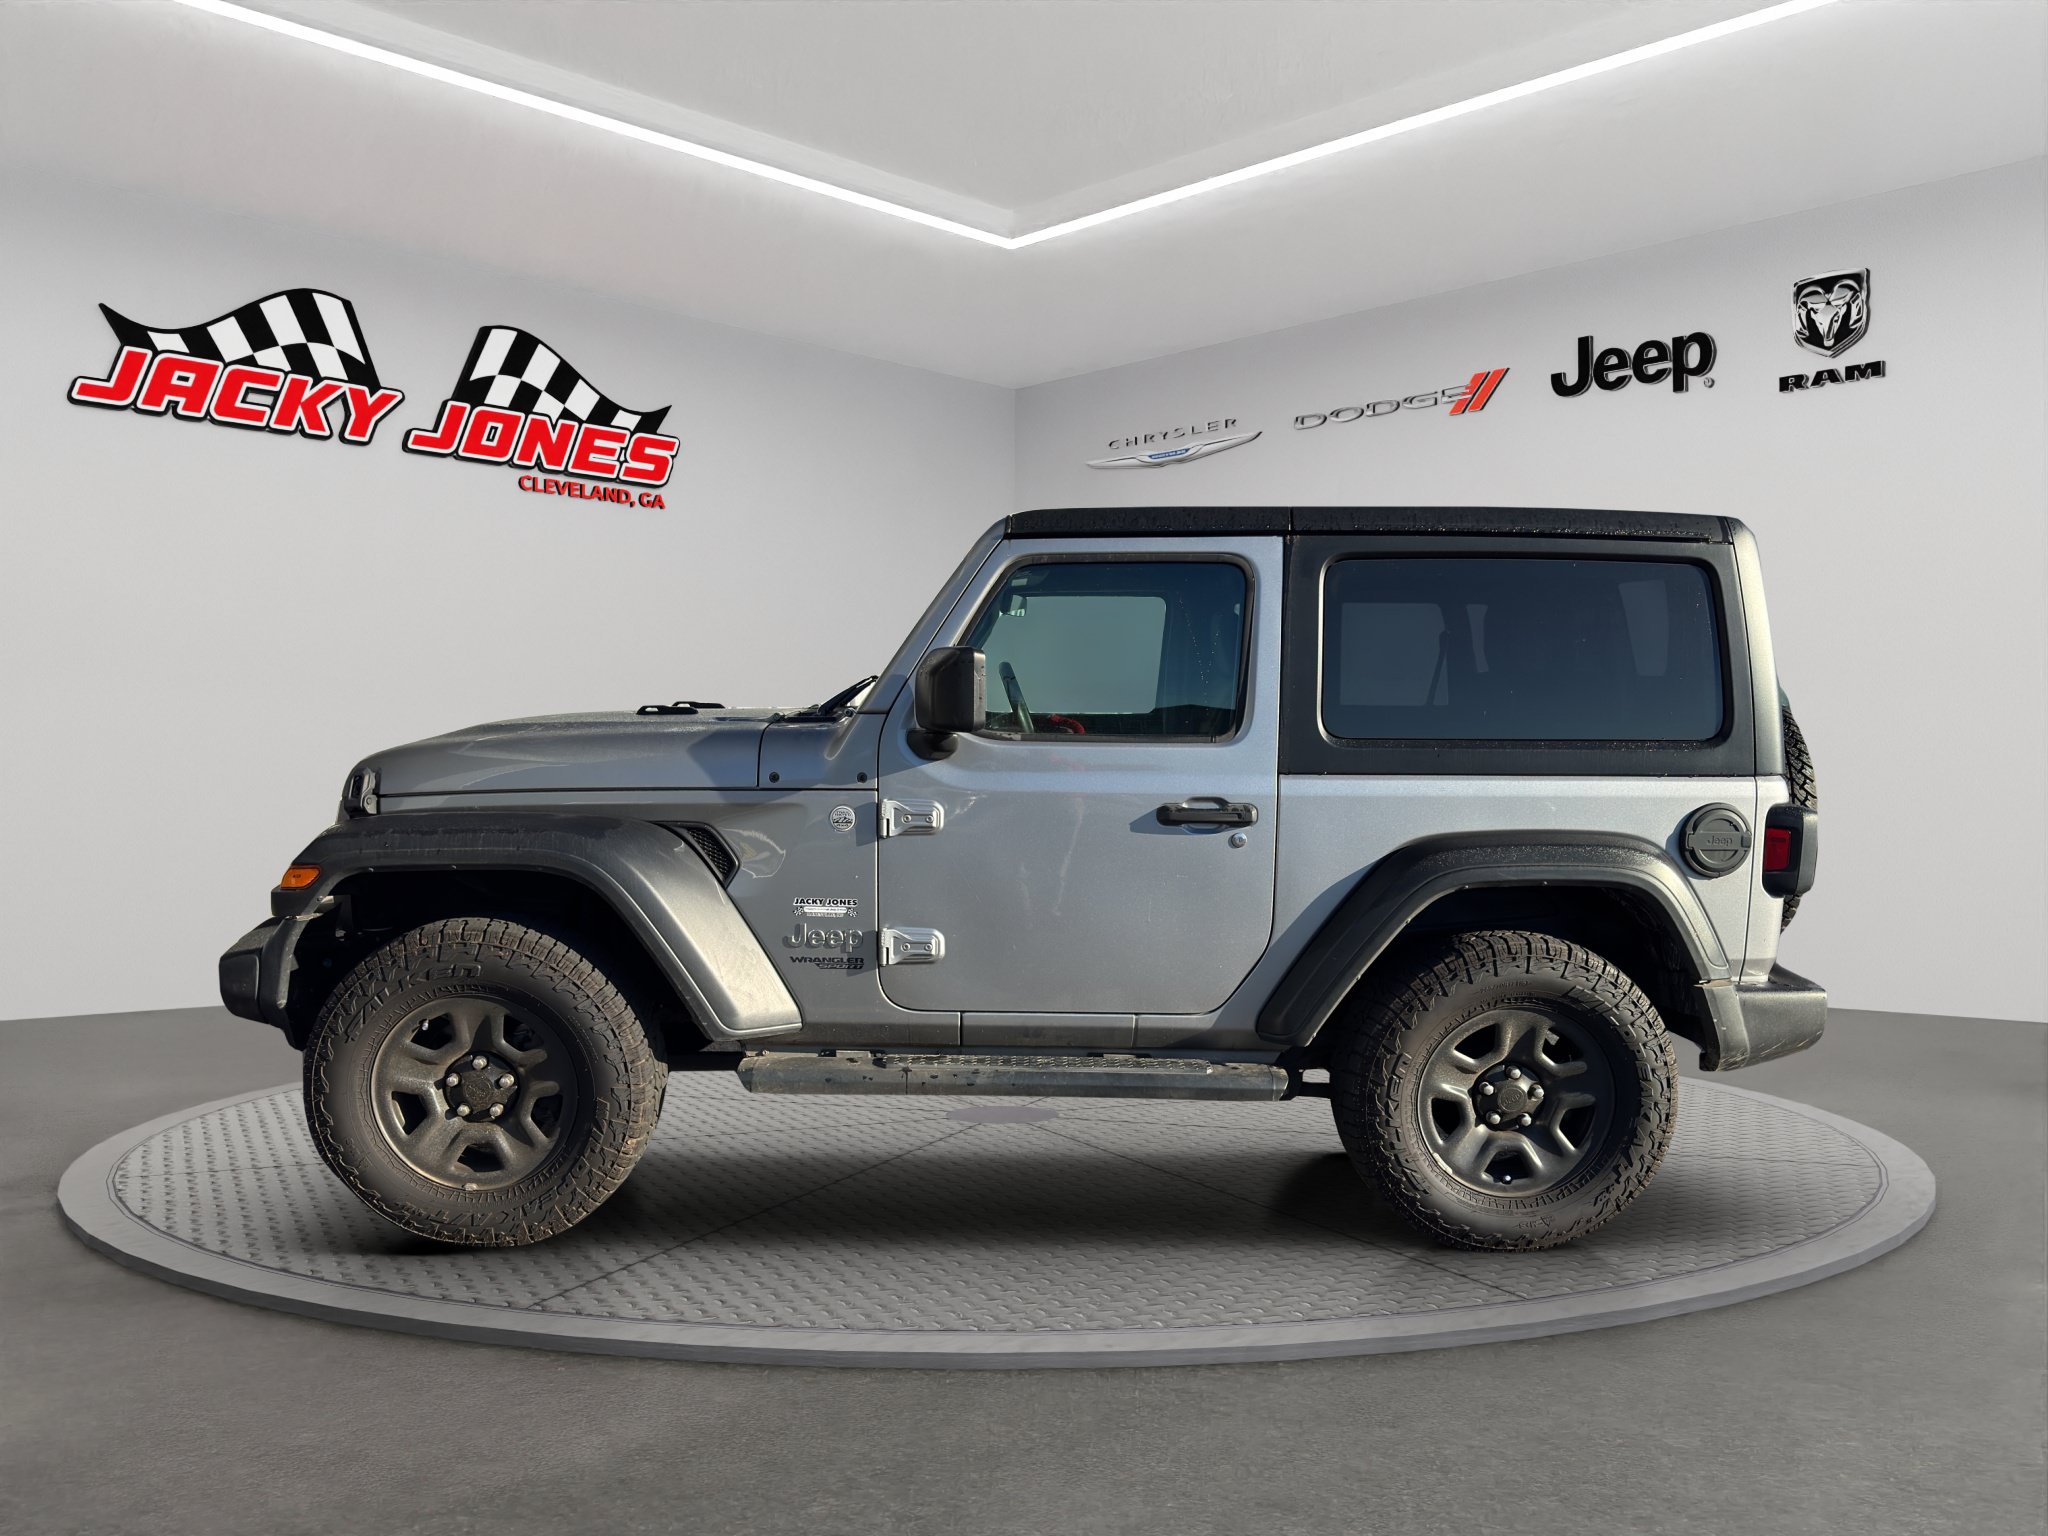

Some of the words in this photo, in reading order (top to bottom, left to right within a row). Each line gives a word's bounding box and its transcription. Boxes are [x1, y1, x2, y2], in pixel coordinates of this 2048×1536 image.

[1550, 331, 1717, 397] Jeep
[1778, 360, 1886, 393] RAM
[69, 346, 403, 443] JACKY
[406, 400, 679, 485] JONES
[1293, 384, 1473, 431] DODGE
[1108, 417, 1238, 450] CHRYSLER
[518, 474, 636, 508] CLEVELAND,
[638, 491, 666, 509] GA
[1706, 835, 1733, 847] Jeep
[793, 897, 825, 906] JACKY
[825, 898, 858, 907] JONES
[786, 922, 863, 953] Jeep
[790, 956, 864, 964] WRANGLER
